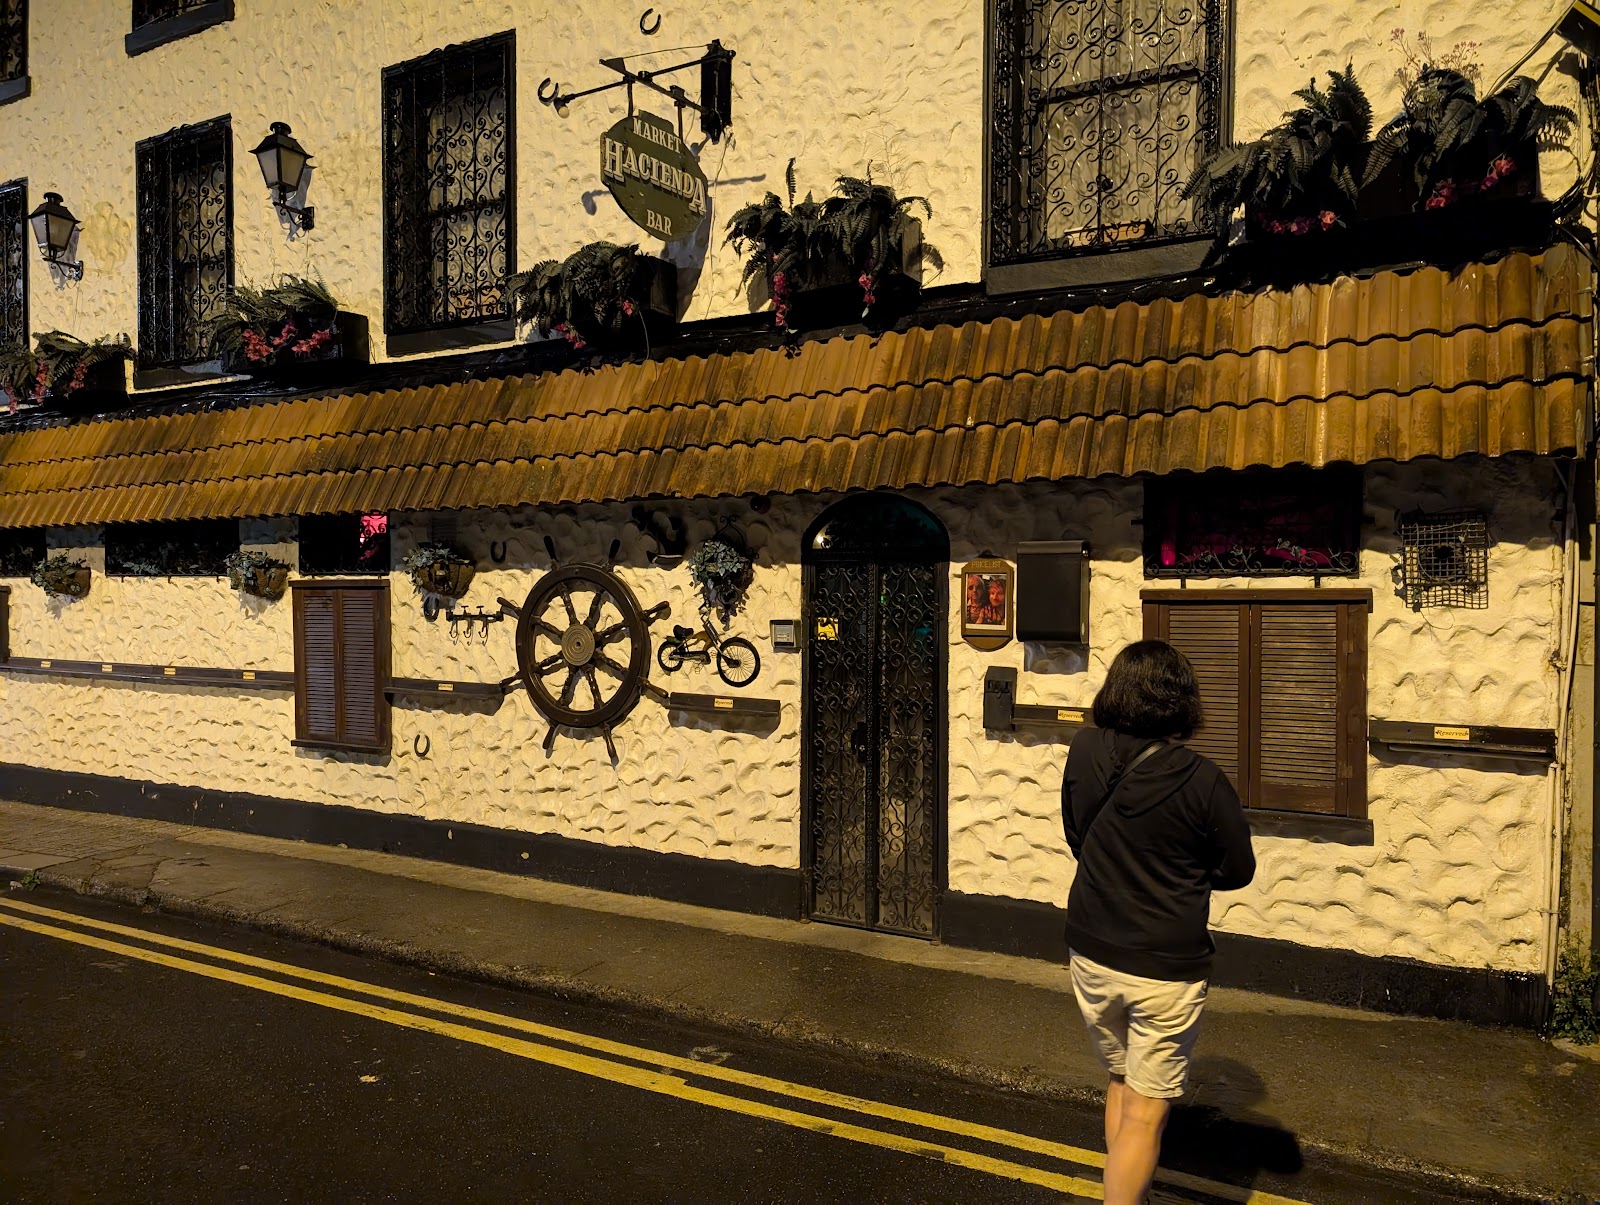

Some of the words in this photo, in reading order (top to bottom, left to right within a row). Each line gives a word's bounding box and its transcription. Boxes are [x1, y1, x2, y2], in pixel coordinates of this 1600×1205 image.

[632, 116, 682, 154] MARKET
[603, 137, 706, 215] HACIENDA
[645, 209, 673, 236] BAR
[1436, 729, 1468, 737] Reserved
